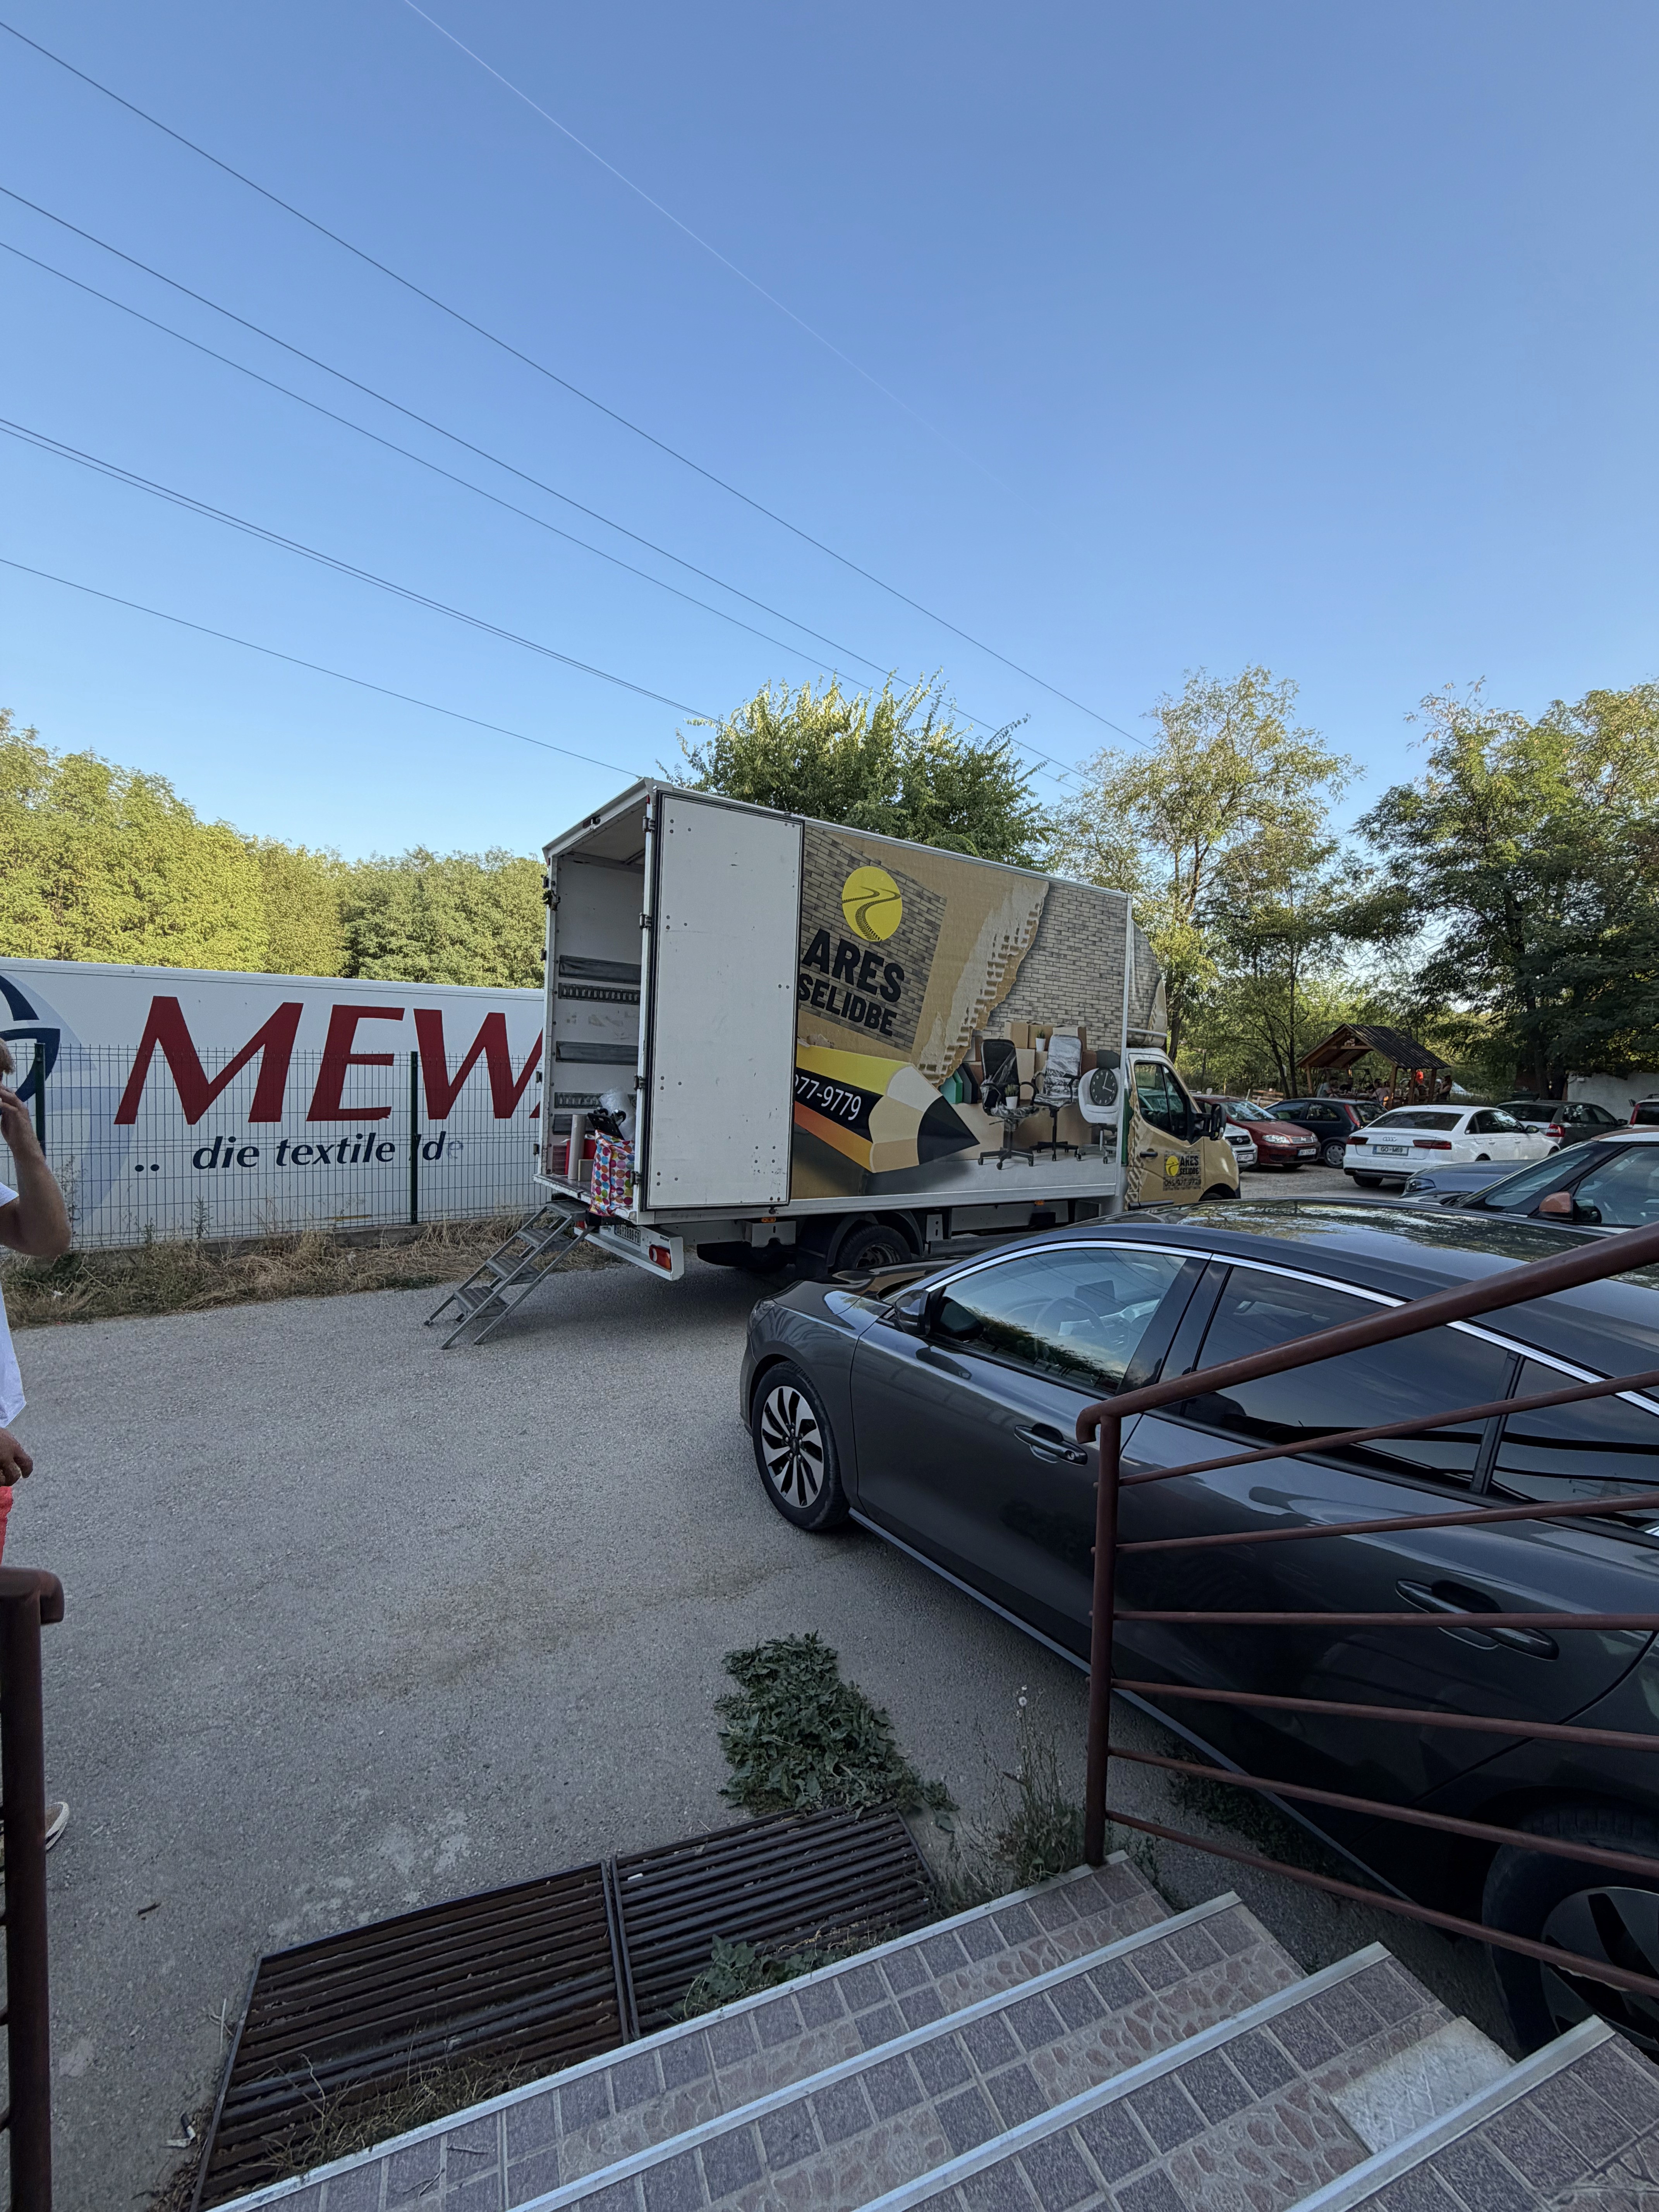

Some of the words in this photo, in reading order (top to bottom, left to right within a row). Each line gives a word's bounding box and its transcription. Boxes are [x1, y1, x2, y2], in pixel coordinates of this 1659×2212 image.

[801, 929, 905, 1003] ARES
[799, 973, 897, 1037] SELIDBE
[113, 996, 543, 1125] MEW
[193, 1135, 260, 1170] die
[276, 1132, 395, 1166] textile
[1180, 1156, 1199, 1166] ARES
